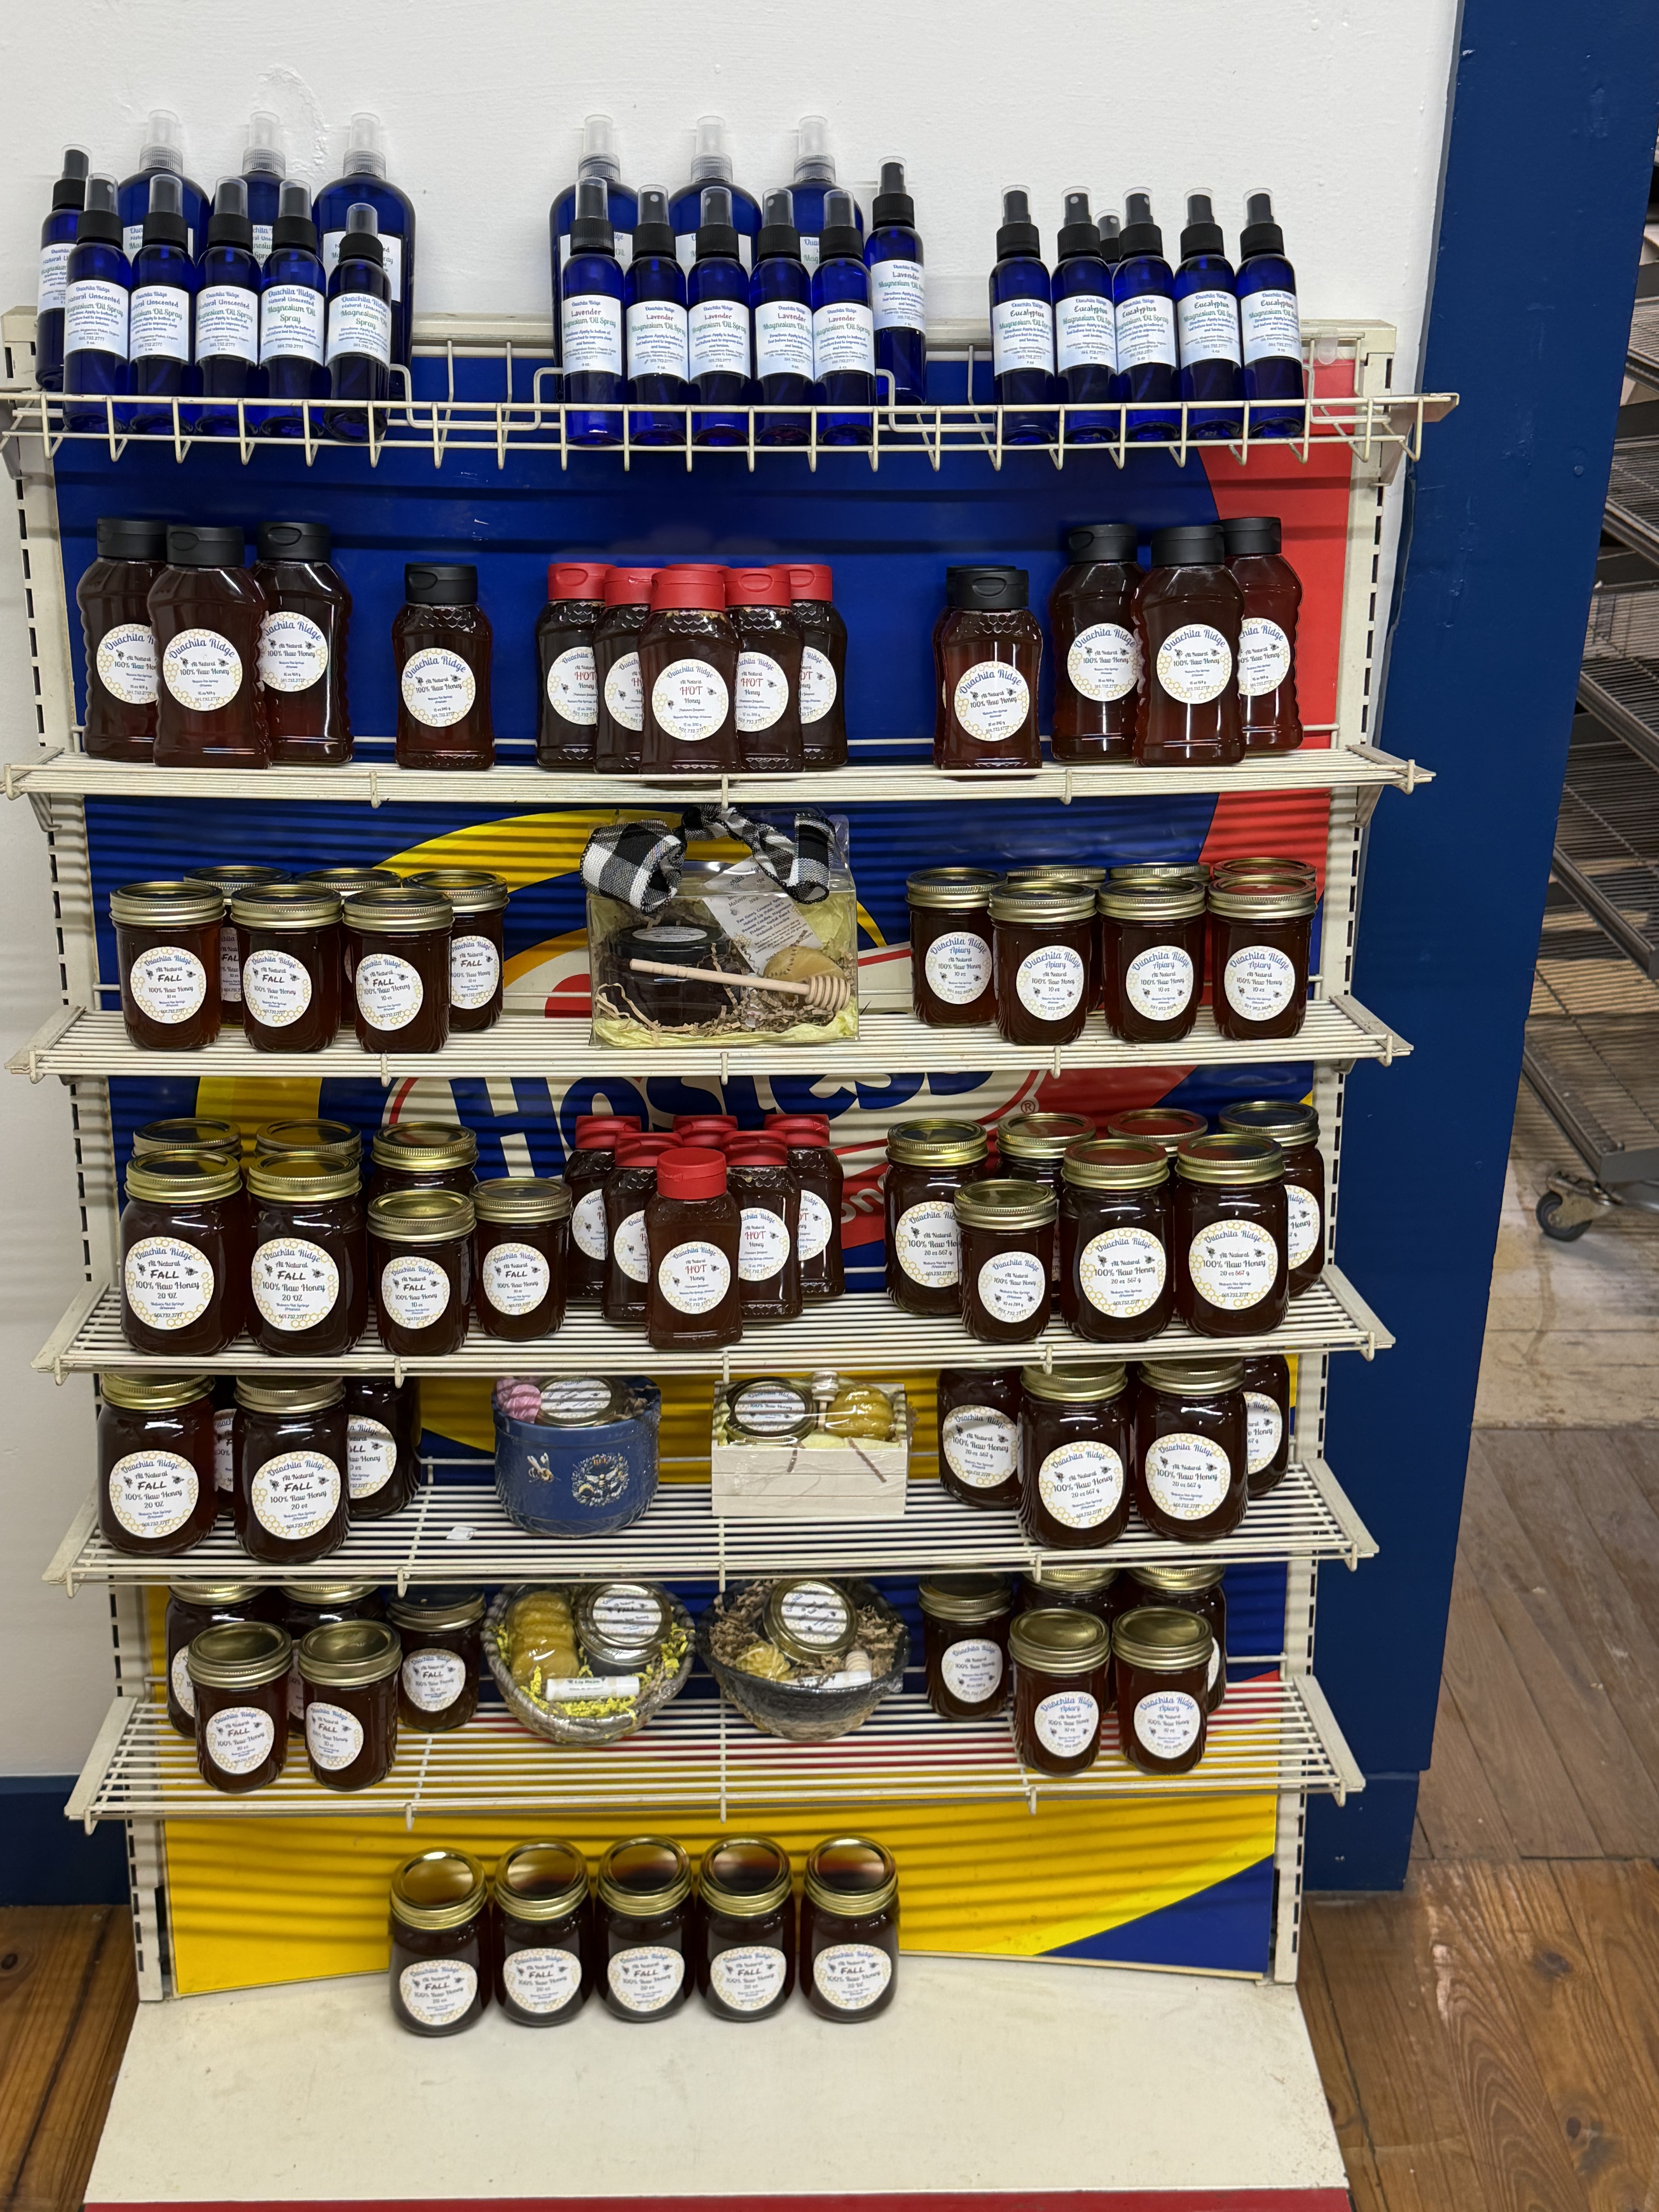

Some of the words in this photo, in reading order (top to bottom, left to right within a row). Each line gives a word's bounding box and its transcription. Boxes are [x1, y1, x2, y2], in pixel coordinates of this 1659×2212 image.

[892, 271, 919, 281] Lavender
[89, 294, 120, 304] Unscented
[297, 289, 315, 300] Ridge
[147, 300, 178, 308] Unscented
[288, 297, 314, 306] Unscented
[1194, 300, 1229, 309] Eucalyptus
[1261, 299, 1294, 309] Eucalyptus
[268, 304, 305, 314] Magnesium
[306, 306, 316, 316] Oil
[572, 308, 601, 317] Lavender
[1010, 309, 1044, 318] Eucalyptus
[1074, 305, 1108, 314] Eucalyptus
[1122, 305, 1156, 318] Eucalyptus
[280, 315, 301, 325] Spray
[341, 310, 379, 321] Magnesium
[778, 313, 806, 322] Lavender
[356, 319, 376, 330] Spray
[632, 322, 663, 332] Magnesium
[763, 322, 797, 330] Magnesium
[297, 621, 322, 641] Ridge
[1113, 628, 1135, 647] Ridge
[1203, 629, 1225, 647] Ridge
[209, 638, 235, 658] Ridge
[441, 655, 466, 673] Ridge
[574, 672, 595, 680] HOT
[696, 666, 715, 678] Ridge
[741, 678, 763, 687] HOT
[998, 669, 1022, 686] Ridge
[680, 686, 703, 696] HOT
[930, 938, 965, 954] Ouachita
[968, 938, 987, 954] Ridge
[174, 955, 192, 965] Ridge
[1024, 952, 1061, 969] Ouachita
[1064, 951, 1081, 969] Ridge
[1230, 951, 1265, 968] Ouachita
[1045, 961, 1066, 969] Apiary
[1153, 961, 1175, 969] Apiary
[1249, 961, 1271, 970] Apiary
[158, 974, 182, 982] FALL
[262, 975, 285, 983] FALL
[373, 979, 395, 987] FALL
[1290, 1220, 1310, 1229] Honey
[745, 1231, 766, 1240] HOT
[1241, 1230, 1262, 1243] Ridge
[1096, 1238, 1129, 1252] Ouachita
[1132, 1237, 1152, 1249] Ridge
[170, 1247, 193, 1261] Ridge
[701, 1247, 716, 1257] Ridge
[1025, 1260, 1039, 1272] Ridge
[1243, 1259, 1266, 1267] Honey
[150, 1269, 179, 1279] FALL
[685, 1264, 707, 1274] HOT
[1095, 1268, 1115, 1276] 100%
[1135, 1266, 1156, 1274] Honey
[277, 1271, 306, 1280] FALL
[175, 1281, 200, 1290] Honey
[301, 1283, 325, 1292] Honey
[358, 1425, 379, 1436] Ridge
[953, 1437, 969, 1446] 100%
[970, 1442, 986, 1450] Raw
[988, 1444, 1008, 1453] Honey
[1086, 1451, 1105, 1460] Ridge
[1194, 1445, 1214, 1457] Ridge
[157, 1459, 179, 1469] Ridge
[1195, 1472, 1218, 1481] Honey
[137, 1481, 167, 1490] FALL
[284, 1482, 313, 1492] FALL
[162, 1489, 183, 1498] Honey
[308, 1490, 328, 1499] Honey
[228, 1728, 250, 1736] FALL
[318, 1724, 337, 1732] FALL
